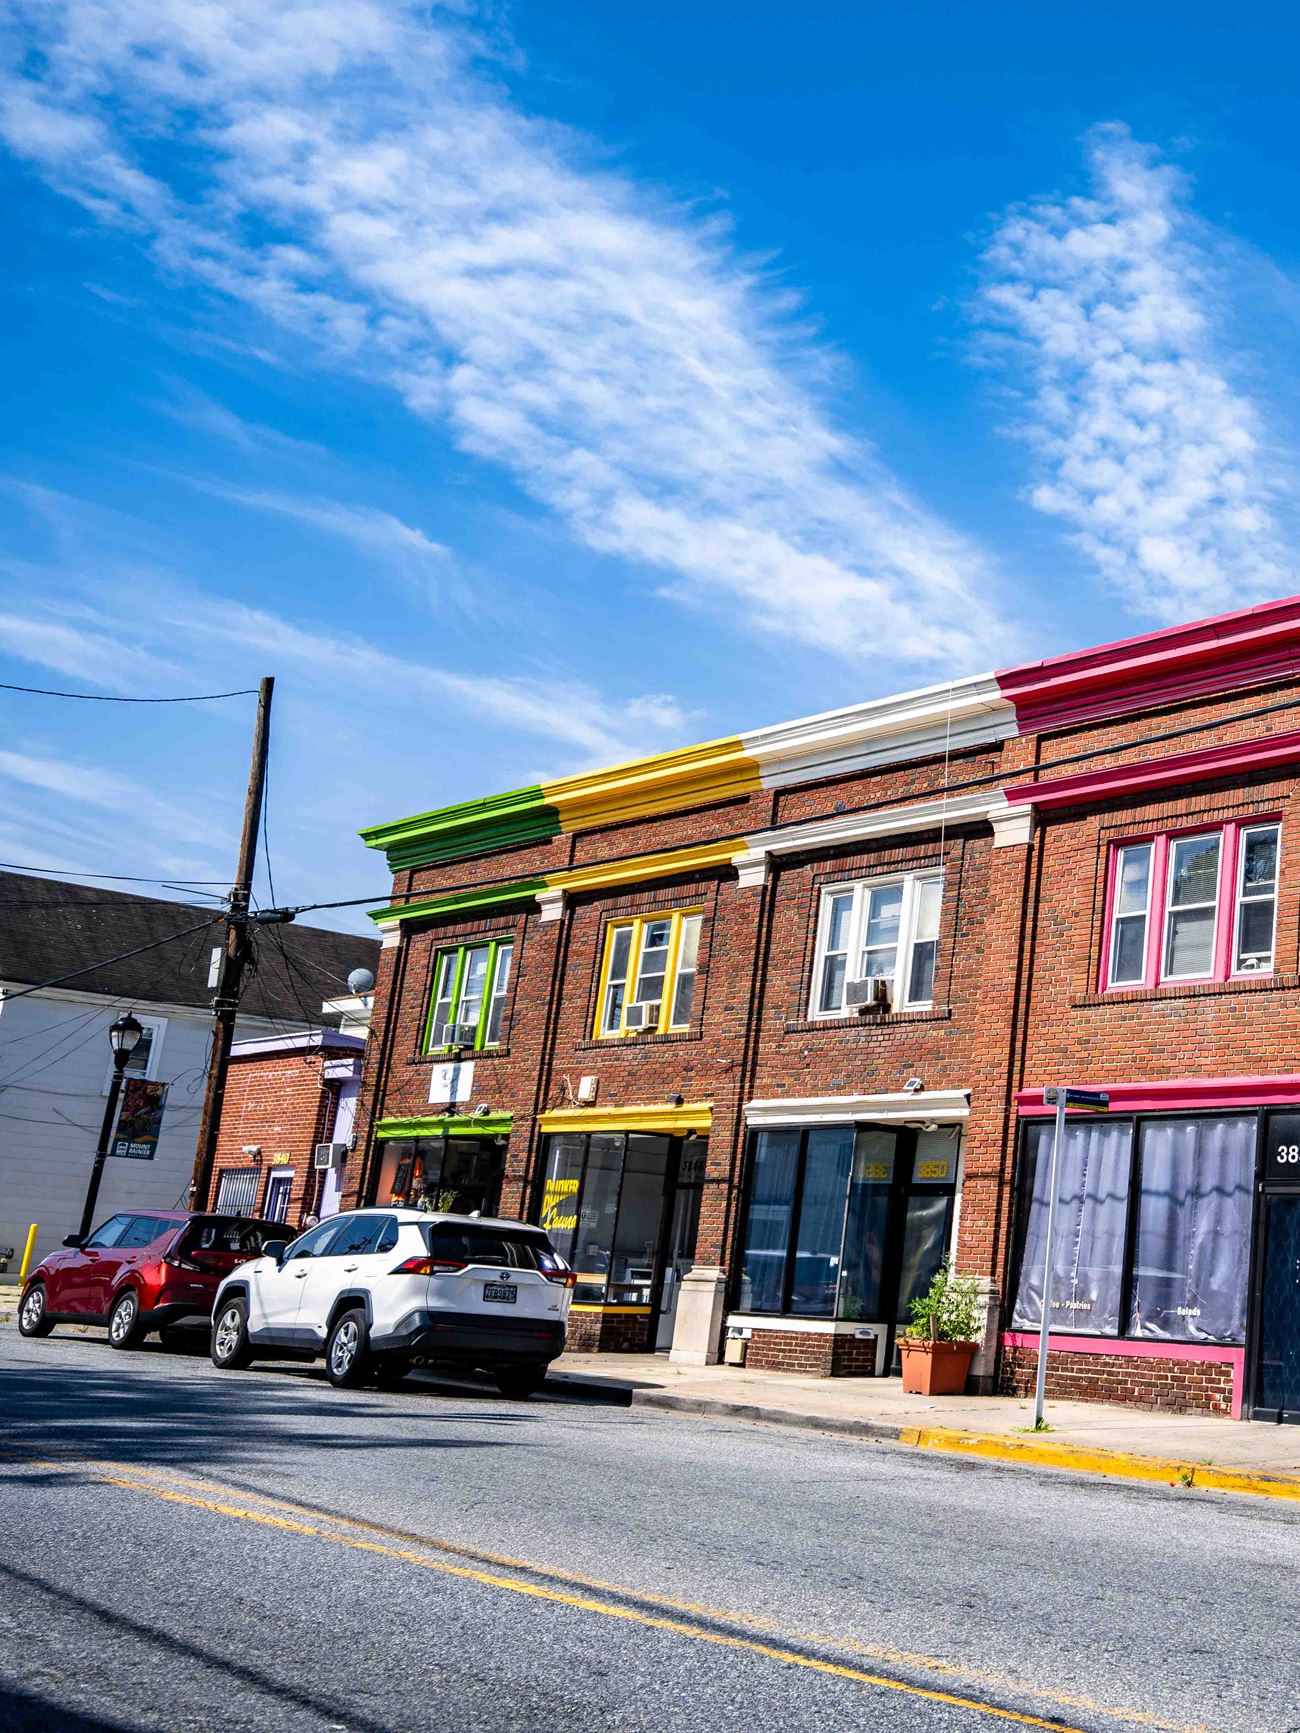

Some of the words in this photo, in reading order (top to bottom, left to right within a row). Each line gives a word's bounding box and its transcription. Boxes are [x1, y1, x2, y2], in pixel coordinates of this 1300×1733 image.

[129, 1142, 151, 1150] MOUNT
[1065, 1300, 1092, 1310] Pastries
[1176, 1306, 1201, 1316] Salads
